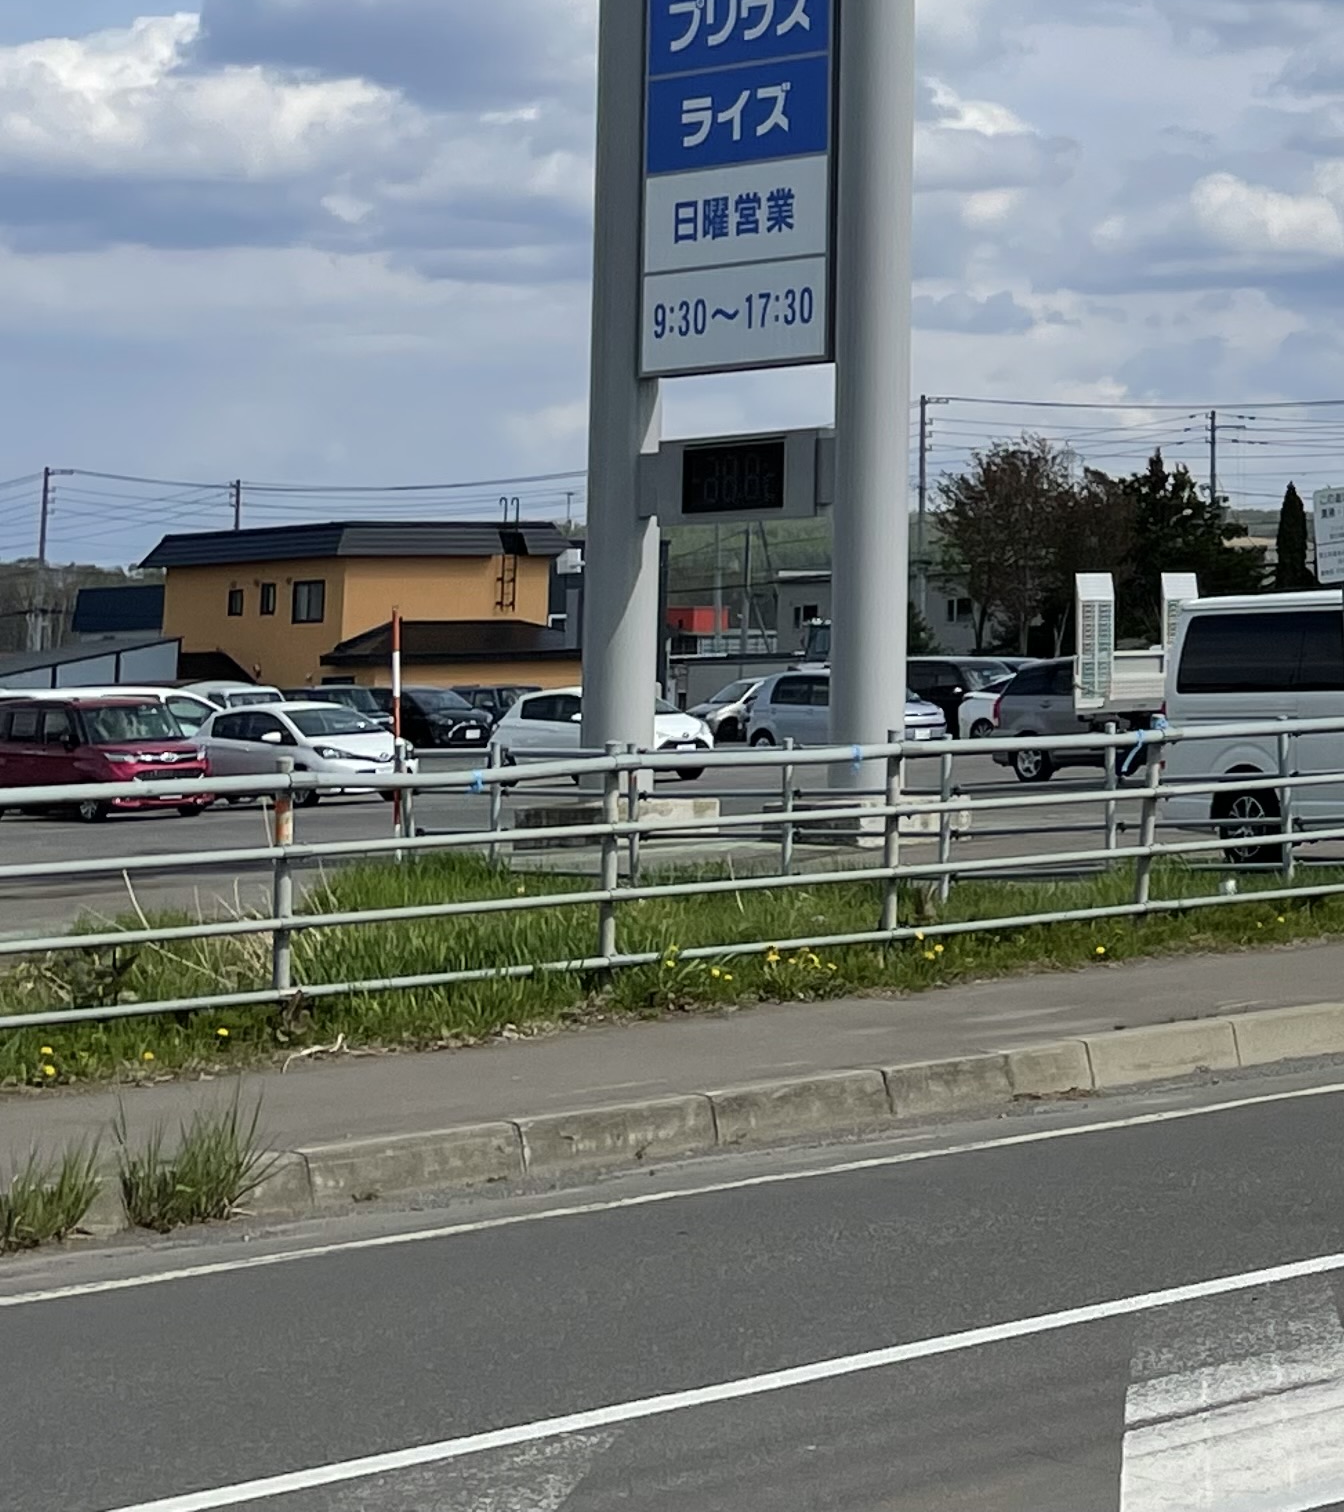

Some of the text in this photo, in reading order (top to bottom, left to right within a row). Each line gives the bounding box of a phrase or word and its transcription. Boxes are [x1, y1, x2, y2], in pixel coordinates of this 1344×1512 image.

[681, 82, 791, 148] ライズ
[673, 187, 796, 245] 日曜営業
